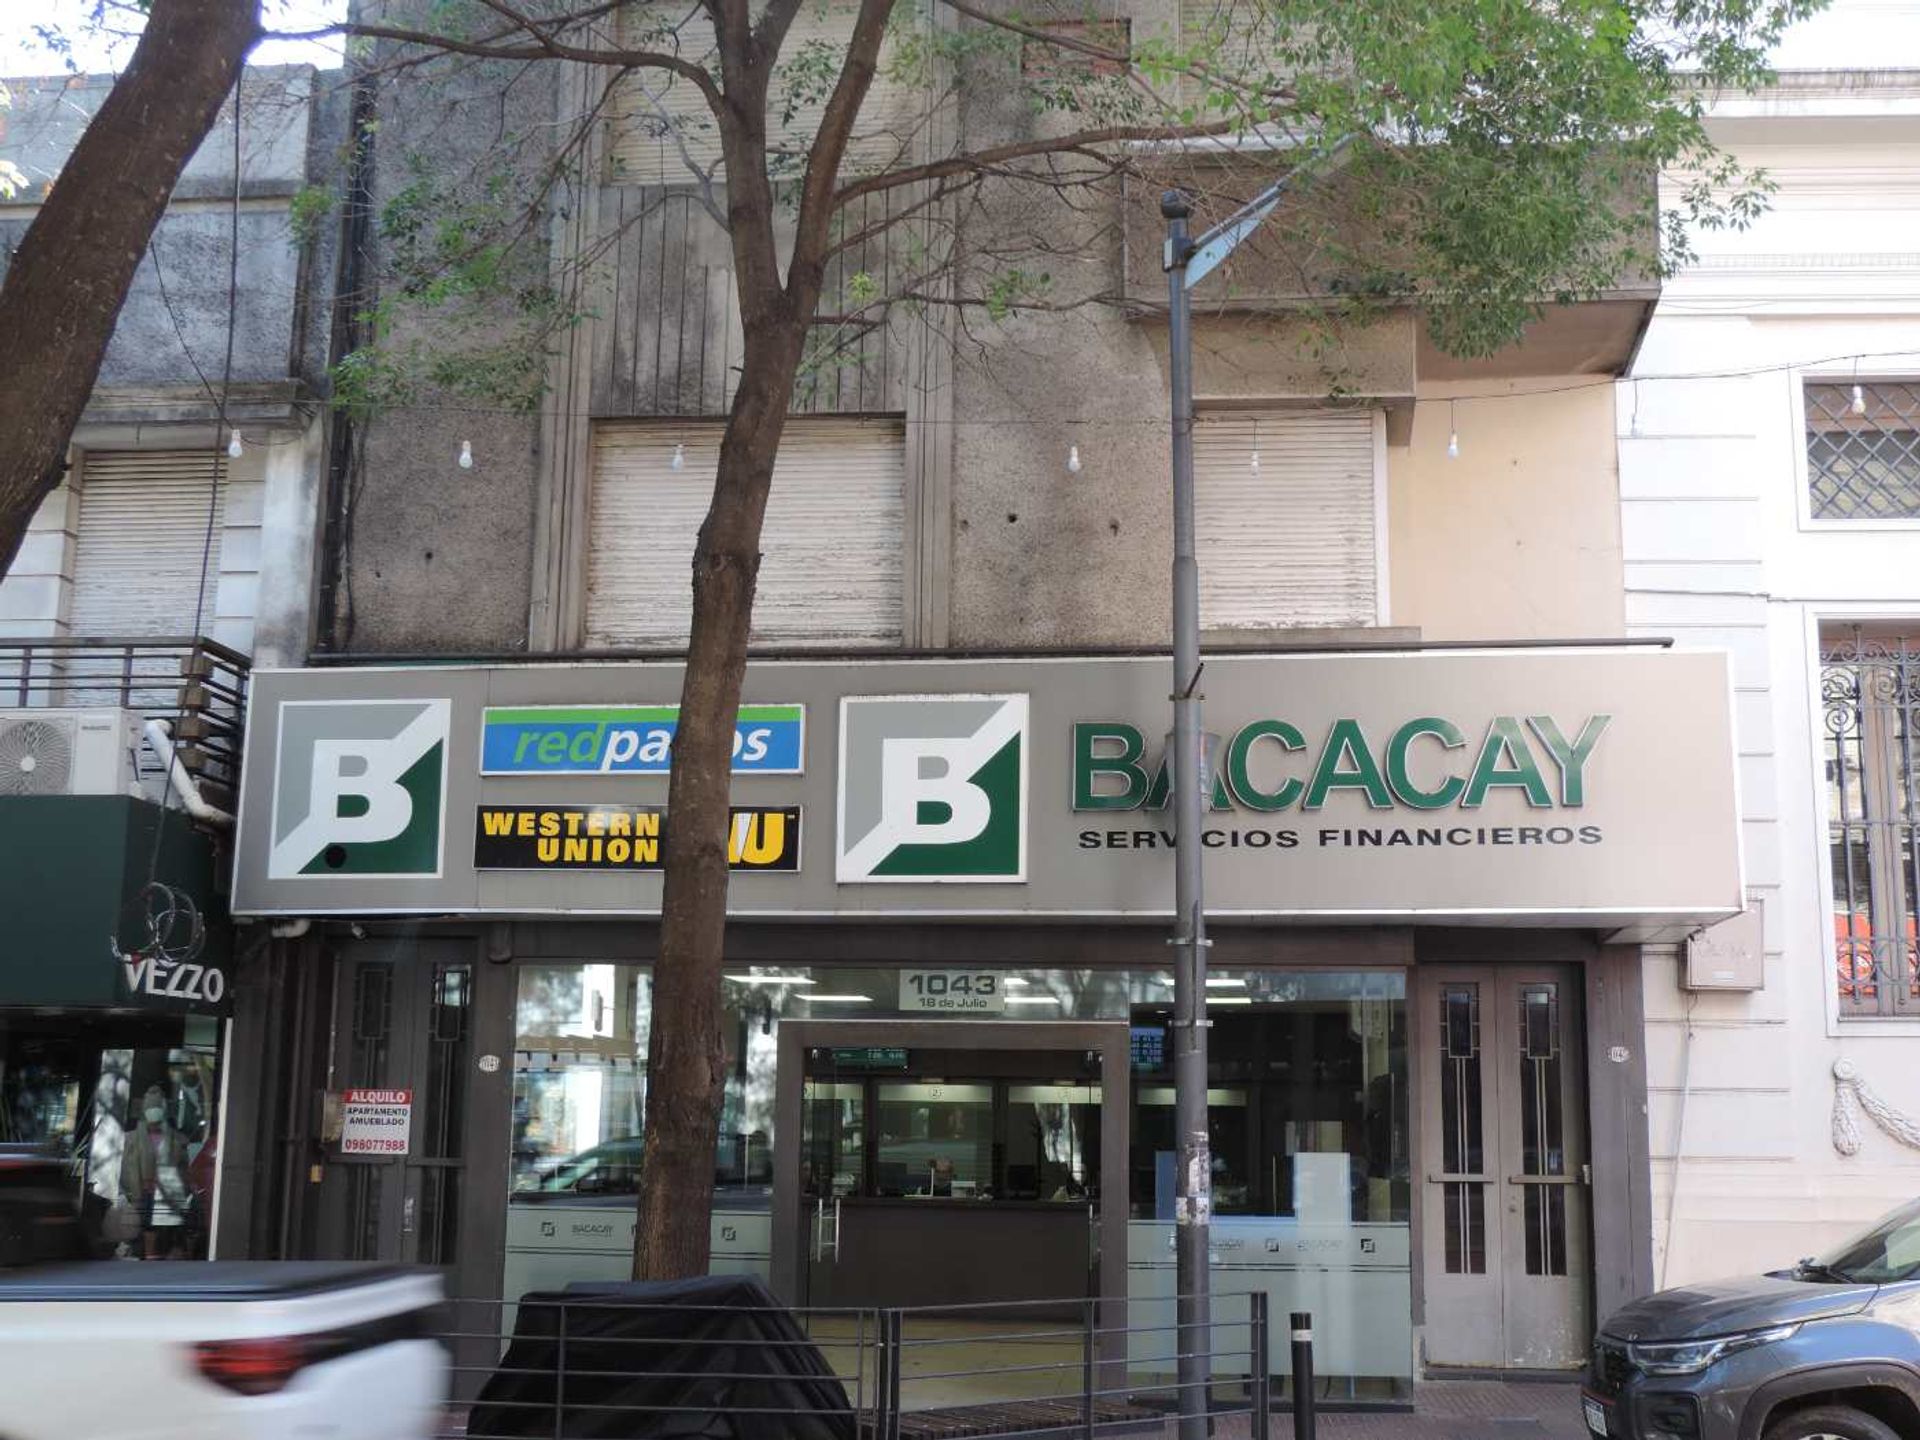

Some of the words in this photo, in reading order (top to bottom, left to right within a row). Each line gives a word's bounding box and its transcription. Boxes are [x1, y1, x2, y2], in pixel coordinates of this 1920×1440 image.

[513, 722, 772, 773] redpas
[482, 812, 660, 837] WESTERN
[1078, 830, 1300, 849] SERVCIOS
[1318, 825, 1603, 846] FINANCIEROS
[536, 838, 658, 862] UNION
[124, 955, 224, 1003] VEZZO
[908, 974, 996, 995] 1043
[919, 997, 936, 1008] 18
[938, 997, 955, 1008] de
[957, 997, 988, 1008] Julio
[350, 1090, 407, 1104] ALQUILO
[347, 1106, 409, 1117] APARTAMENTO
[349, 1116, 405, 1126] AMUEBLADO
